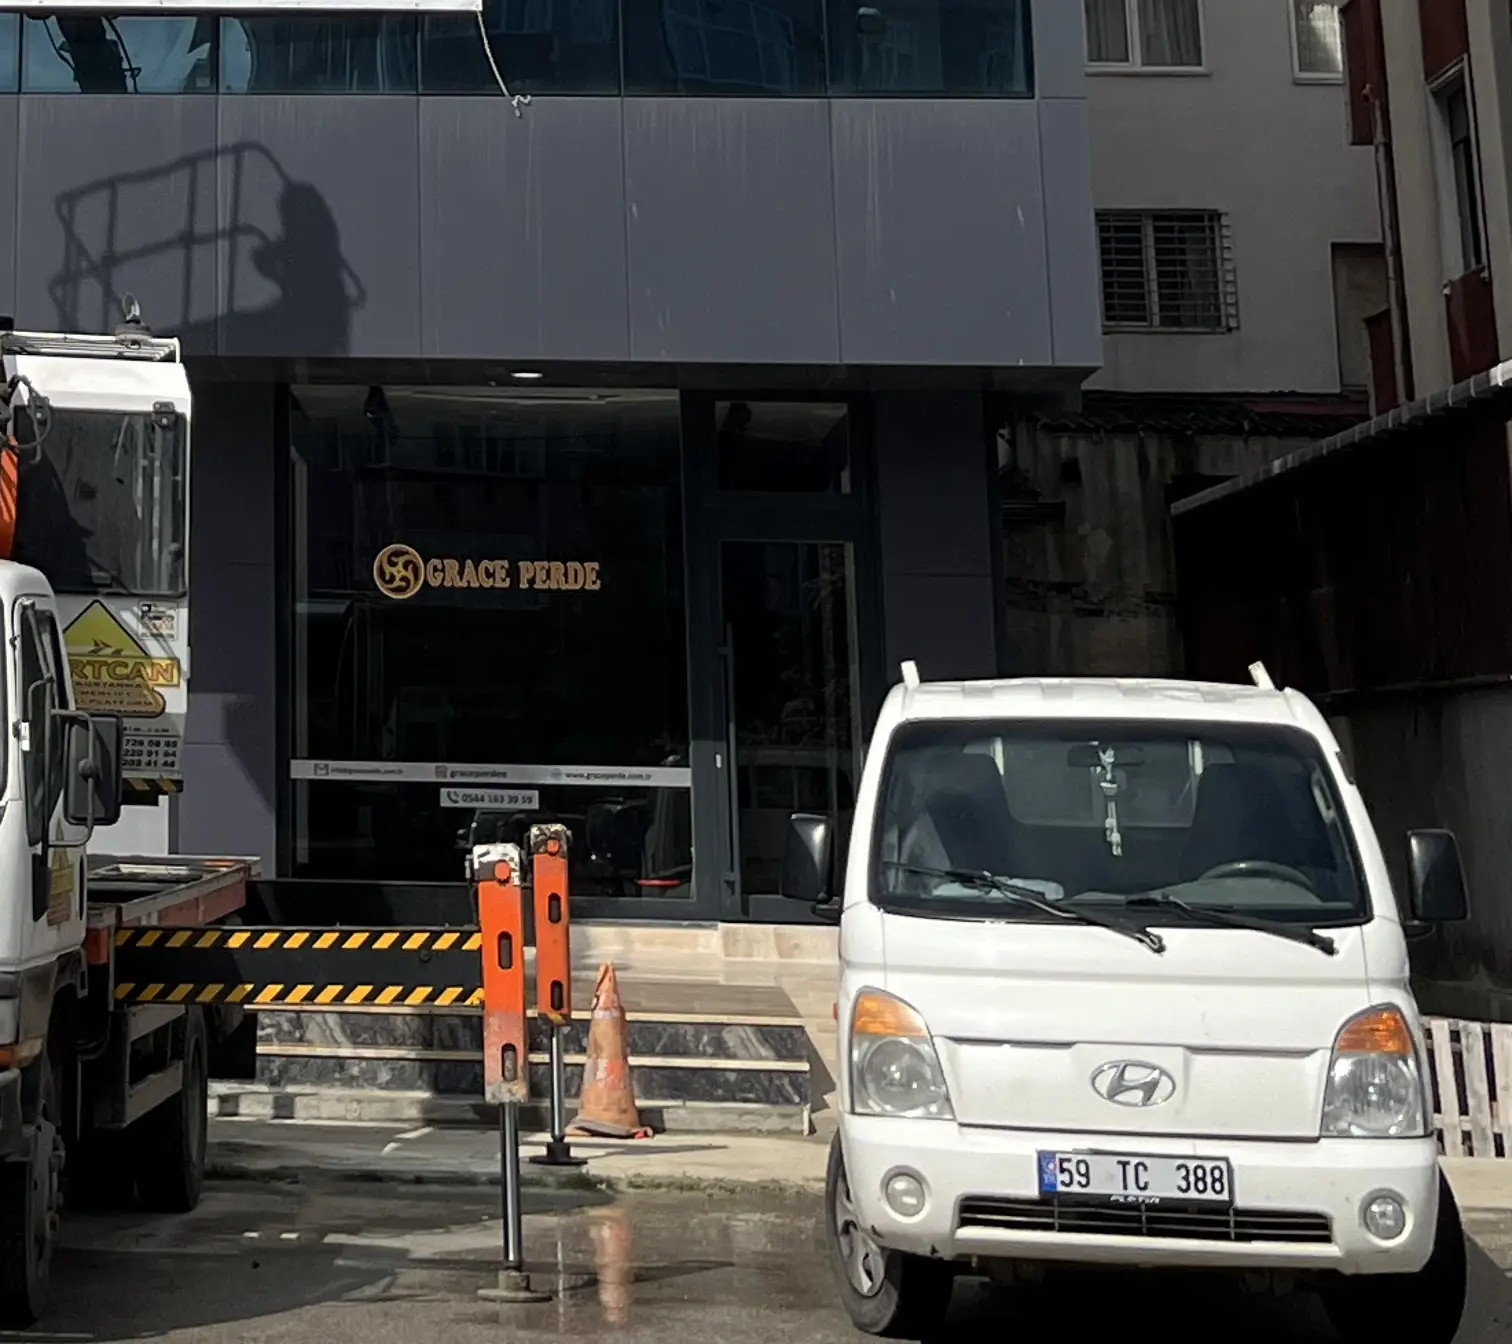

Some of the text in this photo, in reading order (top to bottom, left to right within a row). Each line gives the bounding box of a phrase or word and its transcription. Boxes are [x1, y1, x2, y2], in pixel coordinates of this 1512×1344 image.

[426, 558, 601, 590] GRACE PERDE
[1057, 1157, 1090, 1189] 59
[1116, 1159, 1150, 1192] TC
[1175, 1162, 1225, 1195] 388
